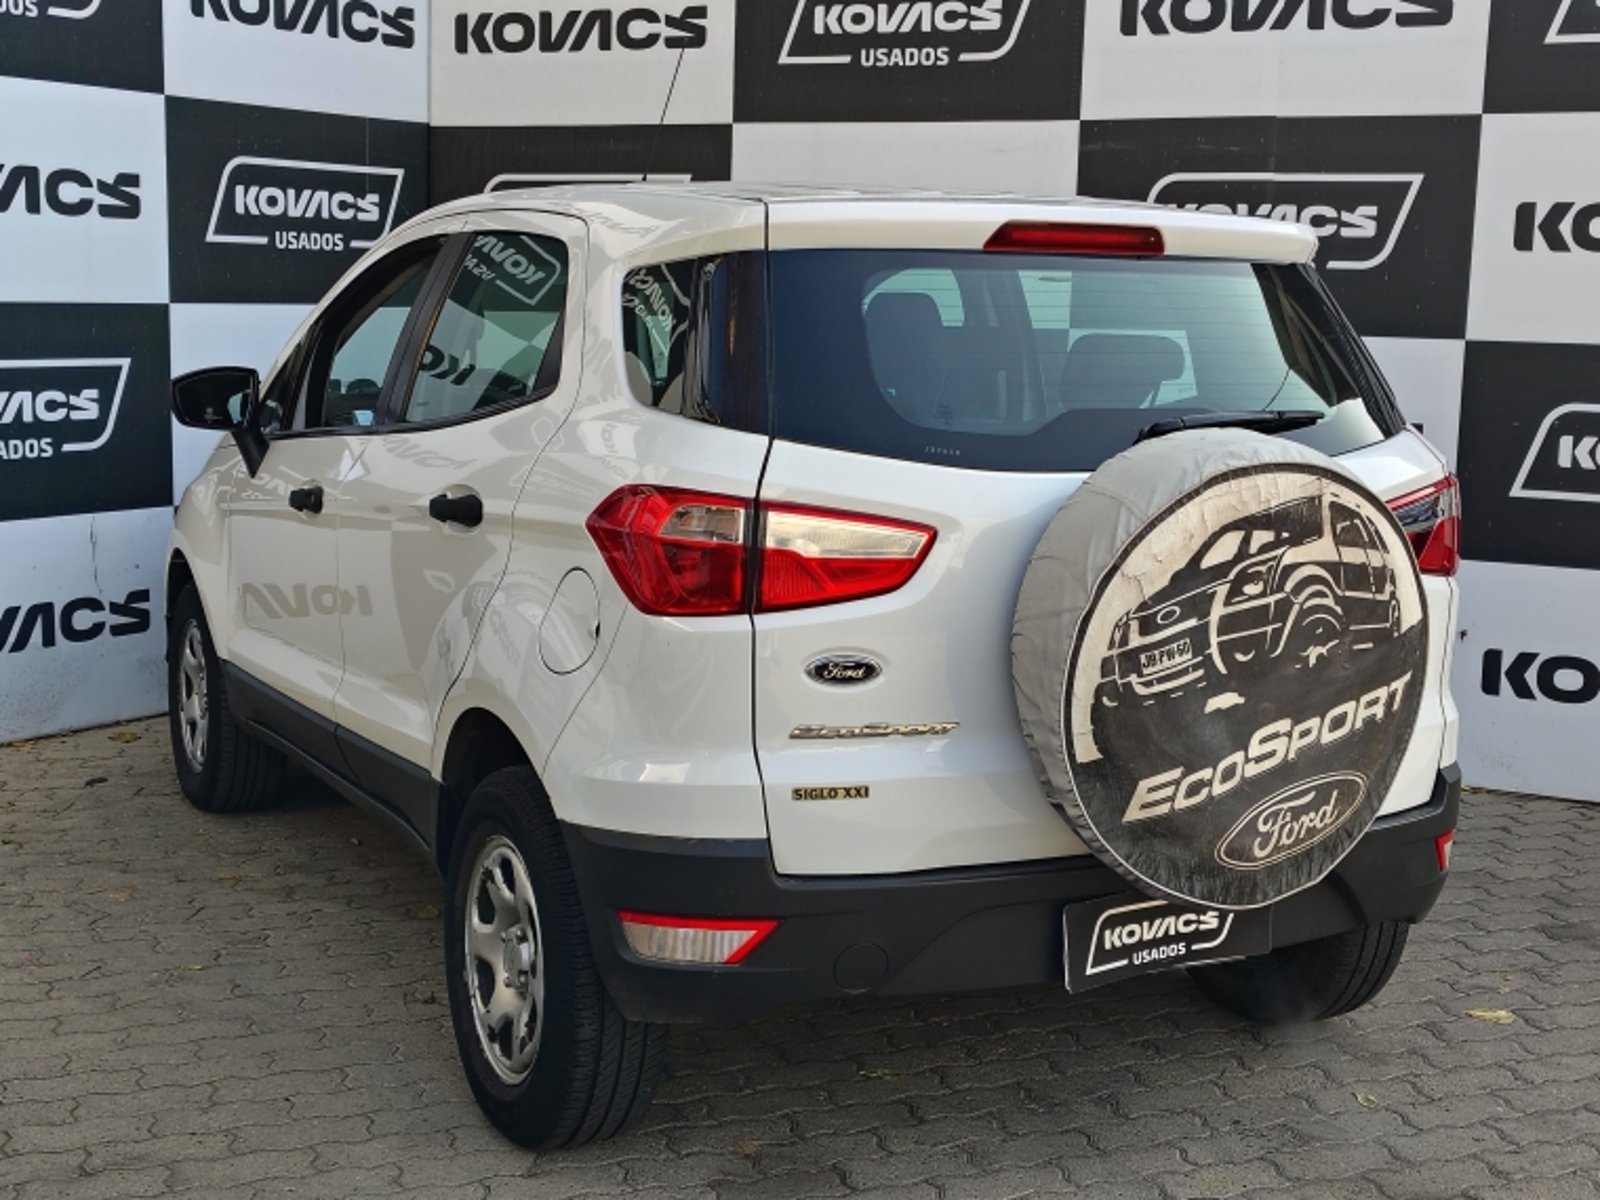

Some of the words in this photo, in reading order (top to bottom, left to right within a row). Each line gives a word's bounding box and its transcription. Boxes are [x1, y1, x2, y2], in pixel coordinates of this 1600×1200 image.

[454, 6, 708, 54] KOVACS
[814, 0, 1002, 34] KOVACS
[860, 47, 949, 67] USADOS
[0, 164, 140, 219] ACS
[235, 184, 379, 221] KOVACS
[275, 231, 344, 250] USADOS
[823, 663, 866, 679] Ford
[794, 788, 838, 800] SIGLO
[843, 786, 869, 799] XXI
[1253, 790, 1341, 858] Ford
[1104, 909, 1221, 950] KOVACS
[1132, 942, 1187, 966] USADOS
